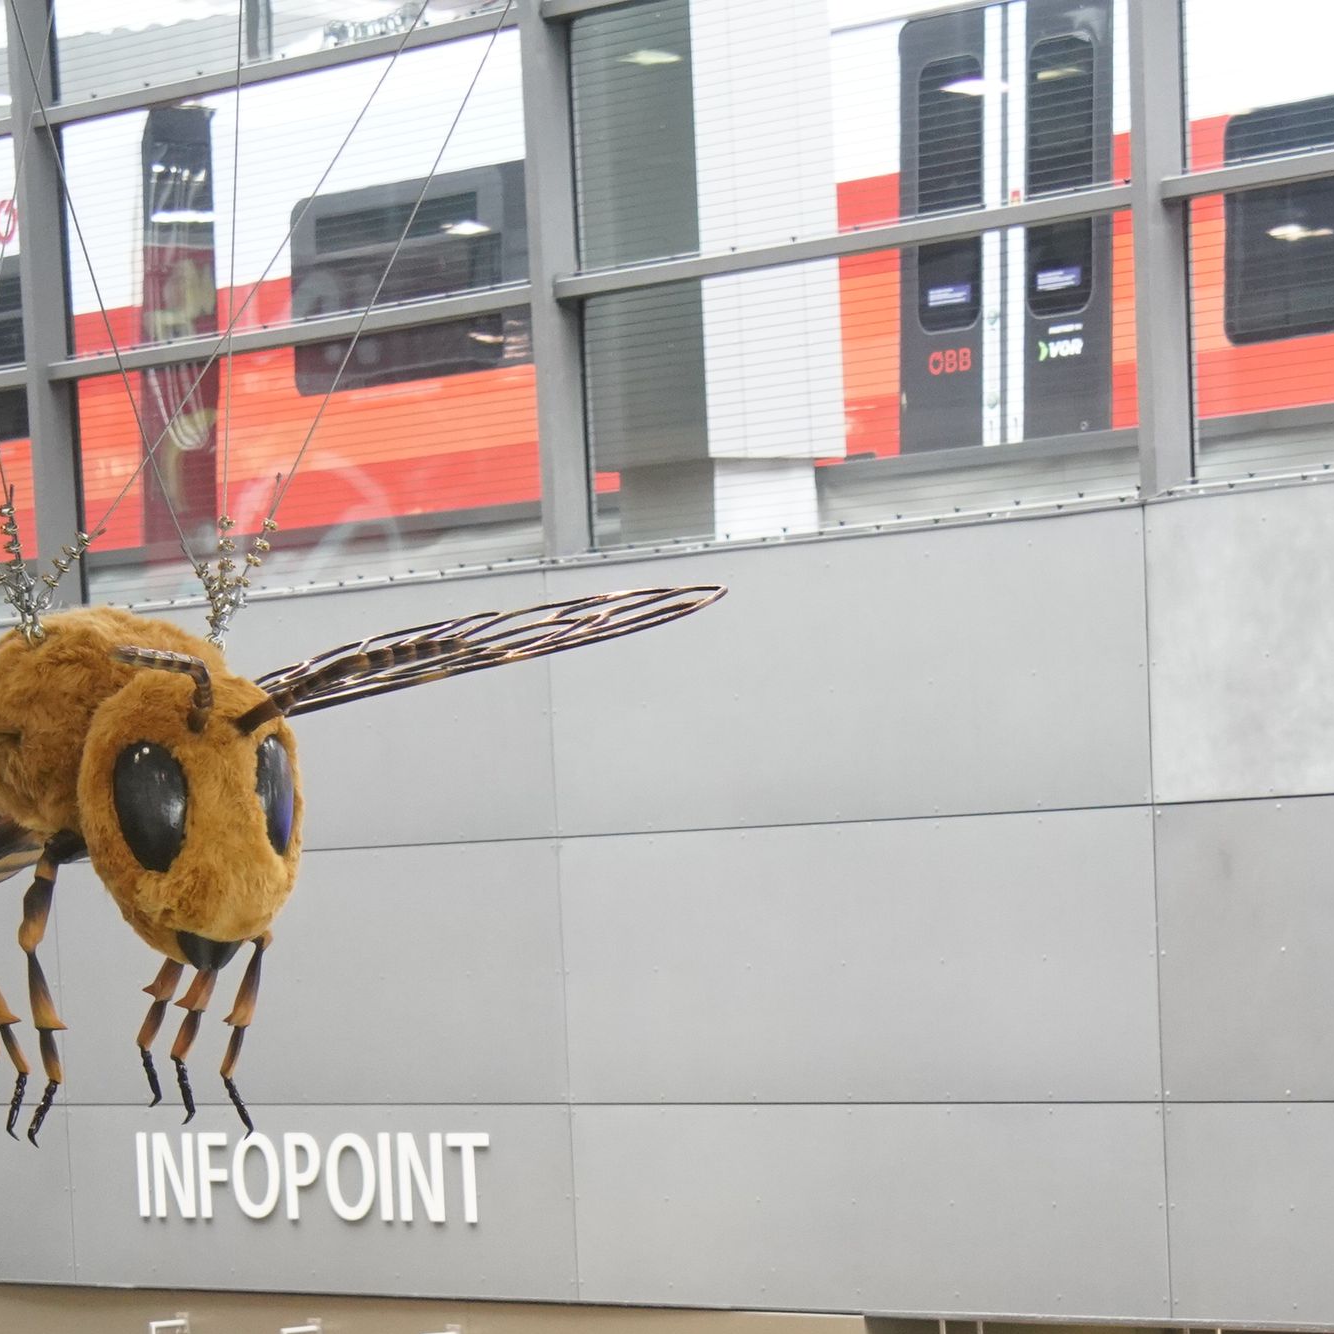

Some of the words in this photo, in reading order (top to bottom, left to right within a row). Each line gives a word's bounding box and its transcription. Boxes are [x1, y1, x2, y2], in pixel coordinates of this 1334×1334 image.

[928, 347, 971, 375] ÖBB
[1049, 338, 1083, 358] VOR
[136, 1131, 490, 1223] INFOPOINT
